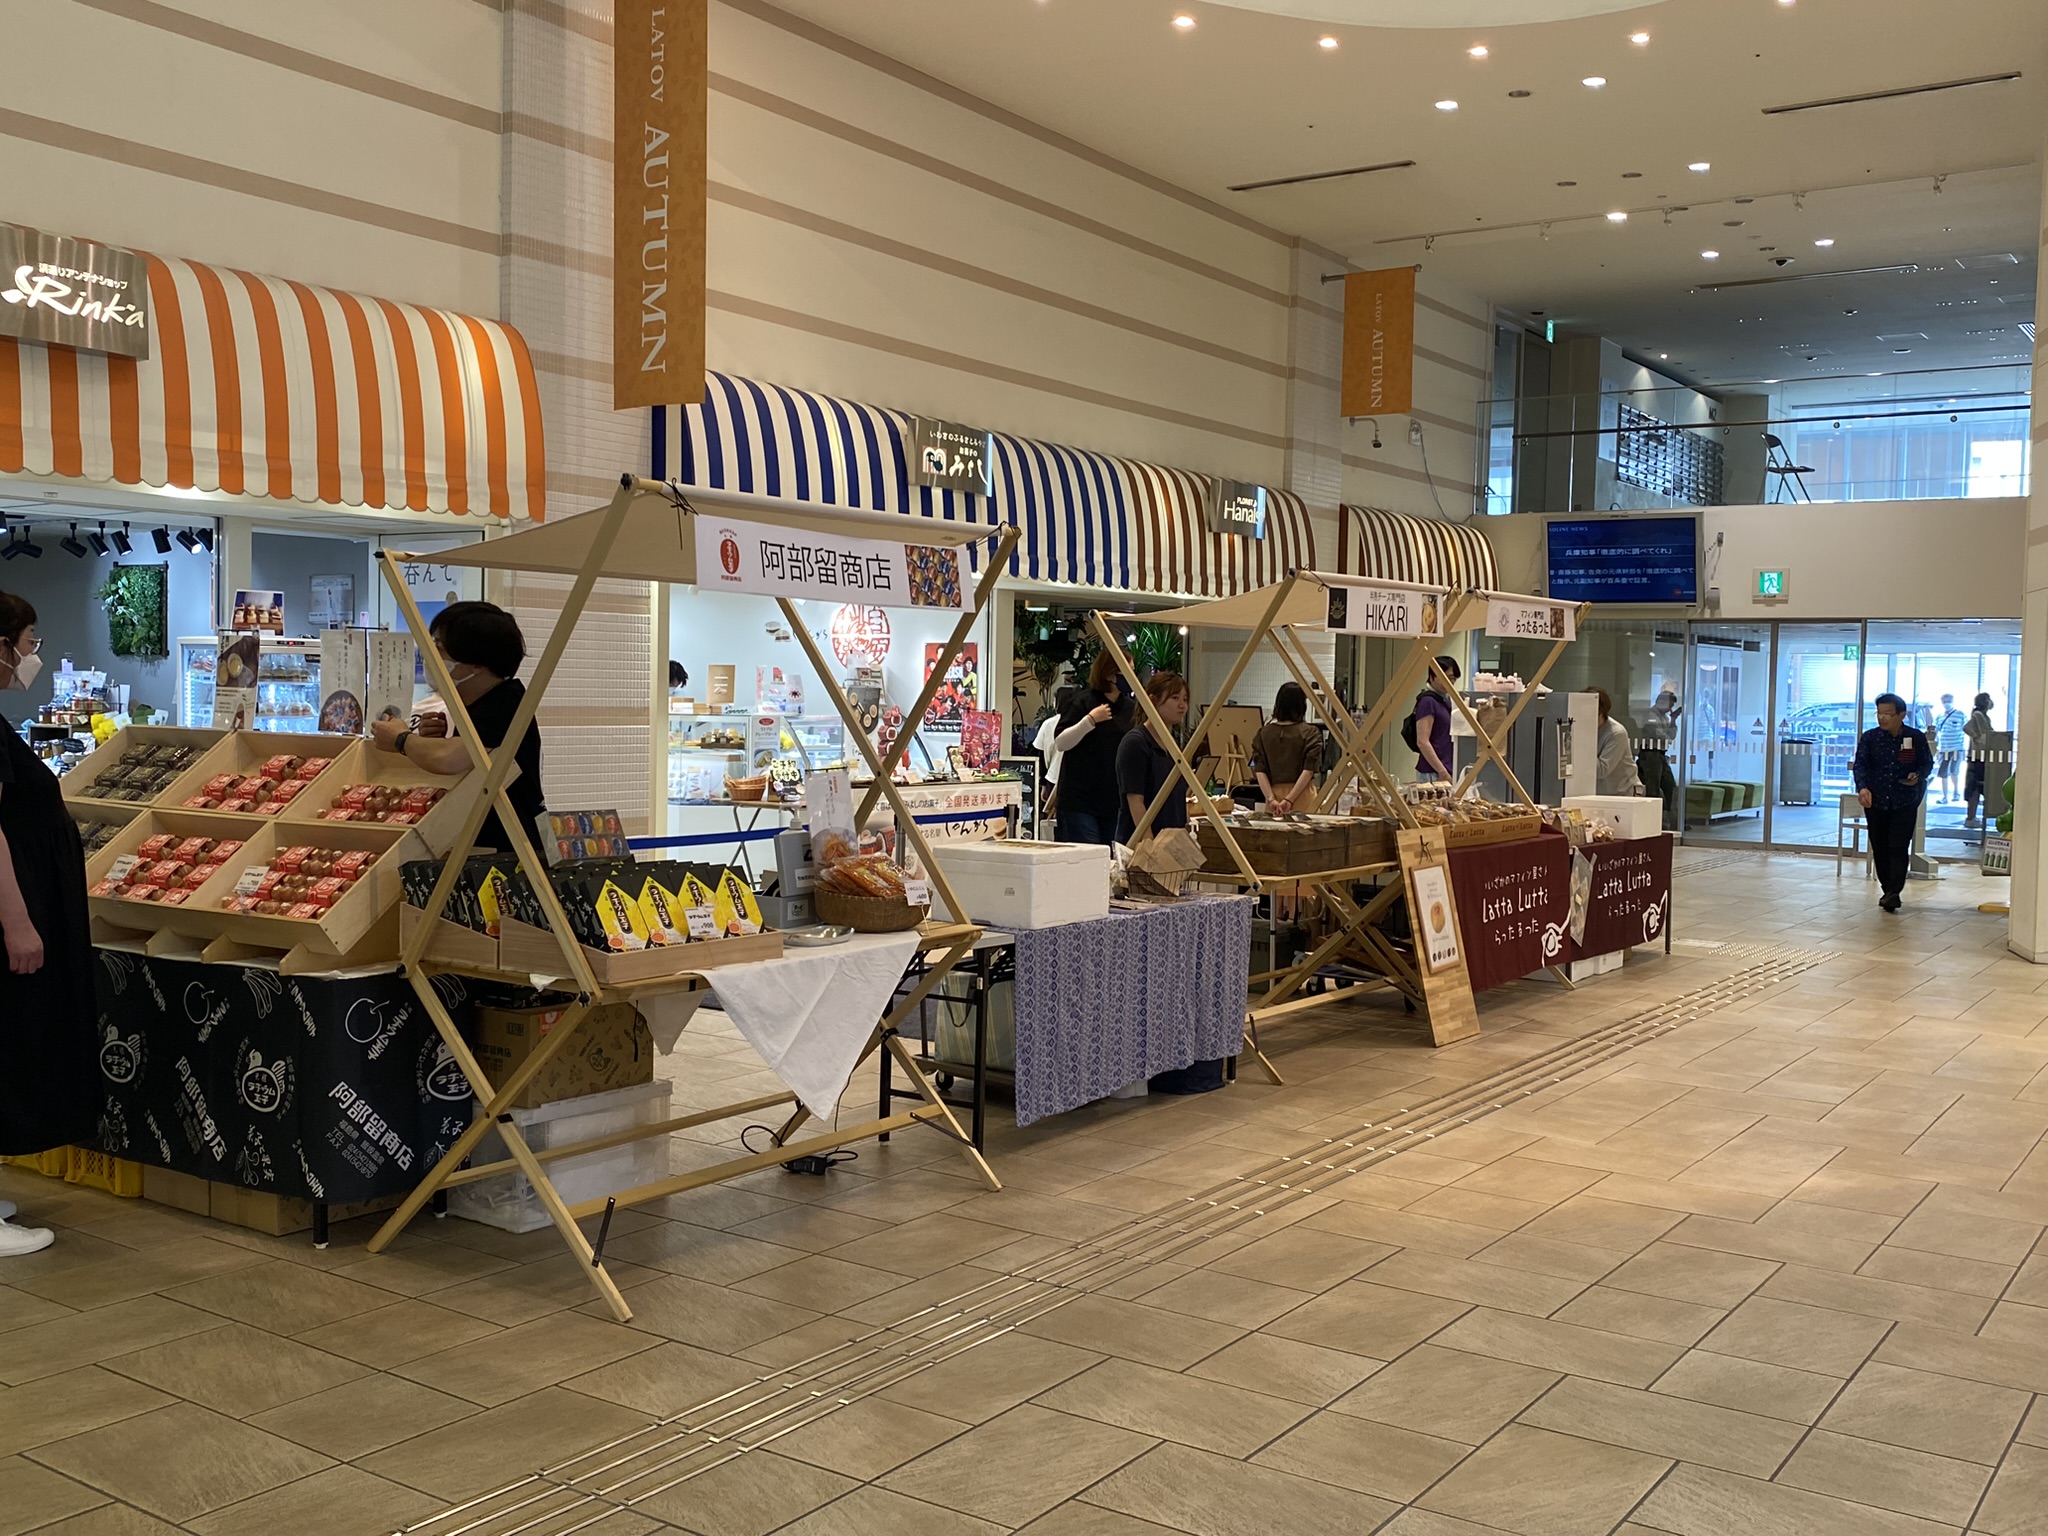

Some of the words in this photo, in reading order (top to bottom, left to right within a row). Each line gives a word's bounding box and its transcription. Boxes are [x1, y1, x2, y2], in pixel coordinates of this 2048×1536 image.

[650, 7, 666, 103] LATOV
[641, 121, 671, 374] AUTUMN
[1375, 293, 1383, 324] LATOV
[1370, 329, 1384, 408] AUTUMN
[759, 540, 892, 591] 阿部留商店
[1365, 603, 1408, 632] HIKARI
[1516, 619, 1549, 634] らったるった
[945, 793, 1012, 808] 全国発送承ります
[1597, 877, 1623, 899] atta
[1627, 870, 1652, 892] Lutta
[1482, 896, 1513, 924] Latta
[1494, 917, 1539, 946] らったるった
[174, 1056, 229, 1163] 阿部留商店
[328, 1080, 416, 1172] 阿部留商店
[328, 1126, 346, 1144] TEL
[324, 1132, 342, 1151] FAX
